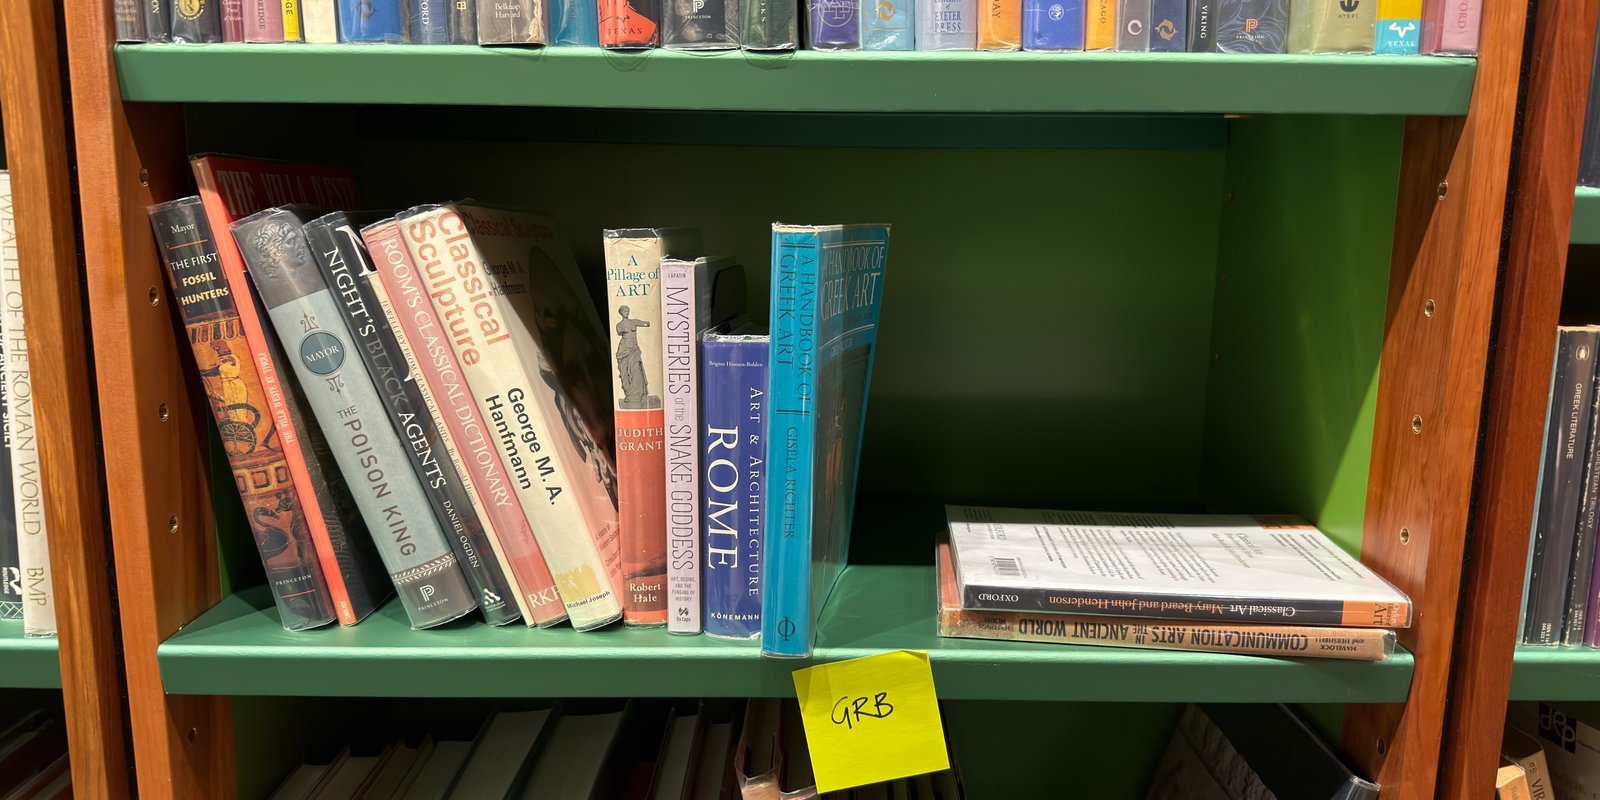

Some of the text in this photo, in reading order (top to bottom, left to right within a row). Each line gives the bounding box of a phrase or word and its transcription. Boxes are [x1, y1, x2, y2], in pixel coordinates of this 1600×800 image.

[420, 0, 430, 24] ORD
[935, 12, 962, 21] EXETER
[1200, 5, 1208, 38] VIKING
[1456, 0, 1468, 29] ORD
[935, 23, 962, 32] PRESS
[1387, 40, 1416, 48] TEXAS
[170, 223, 195, 234] Mayor
[170, 252, 217, 271] THE FIRST
[627, 255, 638, 266] A
[871, 247, 885, 269] OF
[182, 272, 216, 287] FOSSIL
[437, 211, 511, 345] Classical
[607, 267, 660, 282] Pillage of
[181, 287, 229, 306] HUNTERS
[409, 219, 481, 366] Sculpture
[616, 284, 651, 297] ART
[821, 272, 881, 321] GREEK ART
[6, 291, 23, 317] OF
[778, 254, 798, 370] GREEK ART
[797, 255, 815, 403] A HANDBOOK OF
[9, 327, 27, 363] THE
[306, 345, 339, 364] MAYOR
[323, 247, 376, 337] NIGHT'S
[366, 340, 409, 406] BLACK
[398, 411, 447, 489] AGENTS
[381, 238, 513, 509] ROOM'S CLASSICAL DICTIONARY
[382, 300, 449, 443] JEWELLERY FROM CLASSICAL LANDS
[11, 370, 36, 451] ROMAN
[276, 408, 289, 429] VILLA
[337, 405, 358, 419] THE
[1566, 383, 1582, 459] GREEK LITERATURE
[282, 430, 294, 444] THE
[618, 427, 664, 438] JUDITH
[666, 287, 694, 571] MYSTERIES of the SNAKE GODDESS
[485, 394, 532, 490] Hanfmann
[507, 387, 563, 506] George M. A.
[619, 440, 663, 451] GRANT
[344, 418, 417, 557] POISON KING
[749, 387, 764, 596] ART & ARCHITECTURE
[783, 426, 799, 539] GISELA RICHTER
[19, 460, 41, 536] WORLD
[707, 424, 739, 569] ROME
[1587, 497, 1597, 529] TRILOGY
[443, 500, 479, 568] DANIEL OGDEN
[26, 567, 47, 607] BMP
[275, 573, 312, 586] PRINCETON
[629, 582, 661, 593] Robert
[418, 598, 449, 611] PRINCETON
[566, 590, 611, 610] Michael Joseph
[633, 593, 658, 603] Hale
[978, 593, 1019, 602] OXFORD
[1049, 595, 1296, 617] Classical Art Mary Beard and John Henderson
[1373, 603, 1387, 626] Art
[1018, 618, 1309, 651] COMMUNICATION ARTS IN THE ANCIENT WORLD
[1320, 644, 1357, 652] HAVELOCK
[831, 692, 894, 729] GRB
